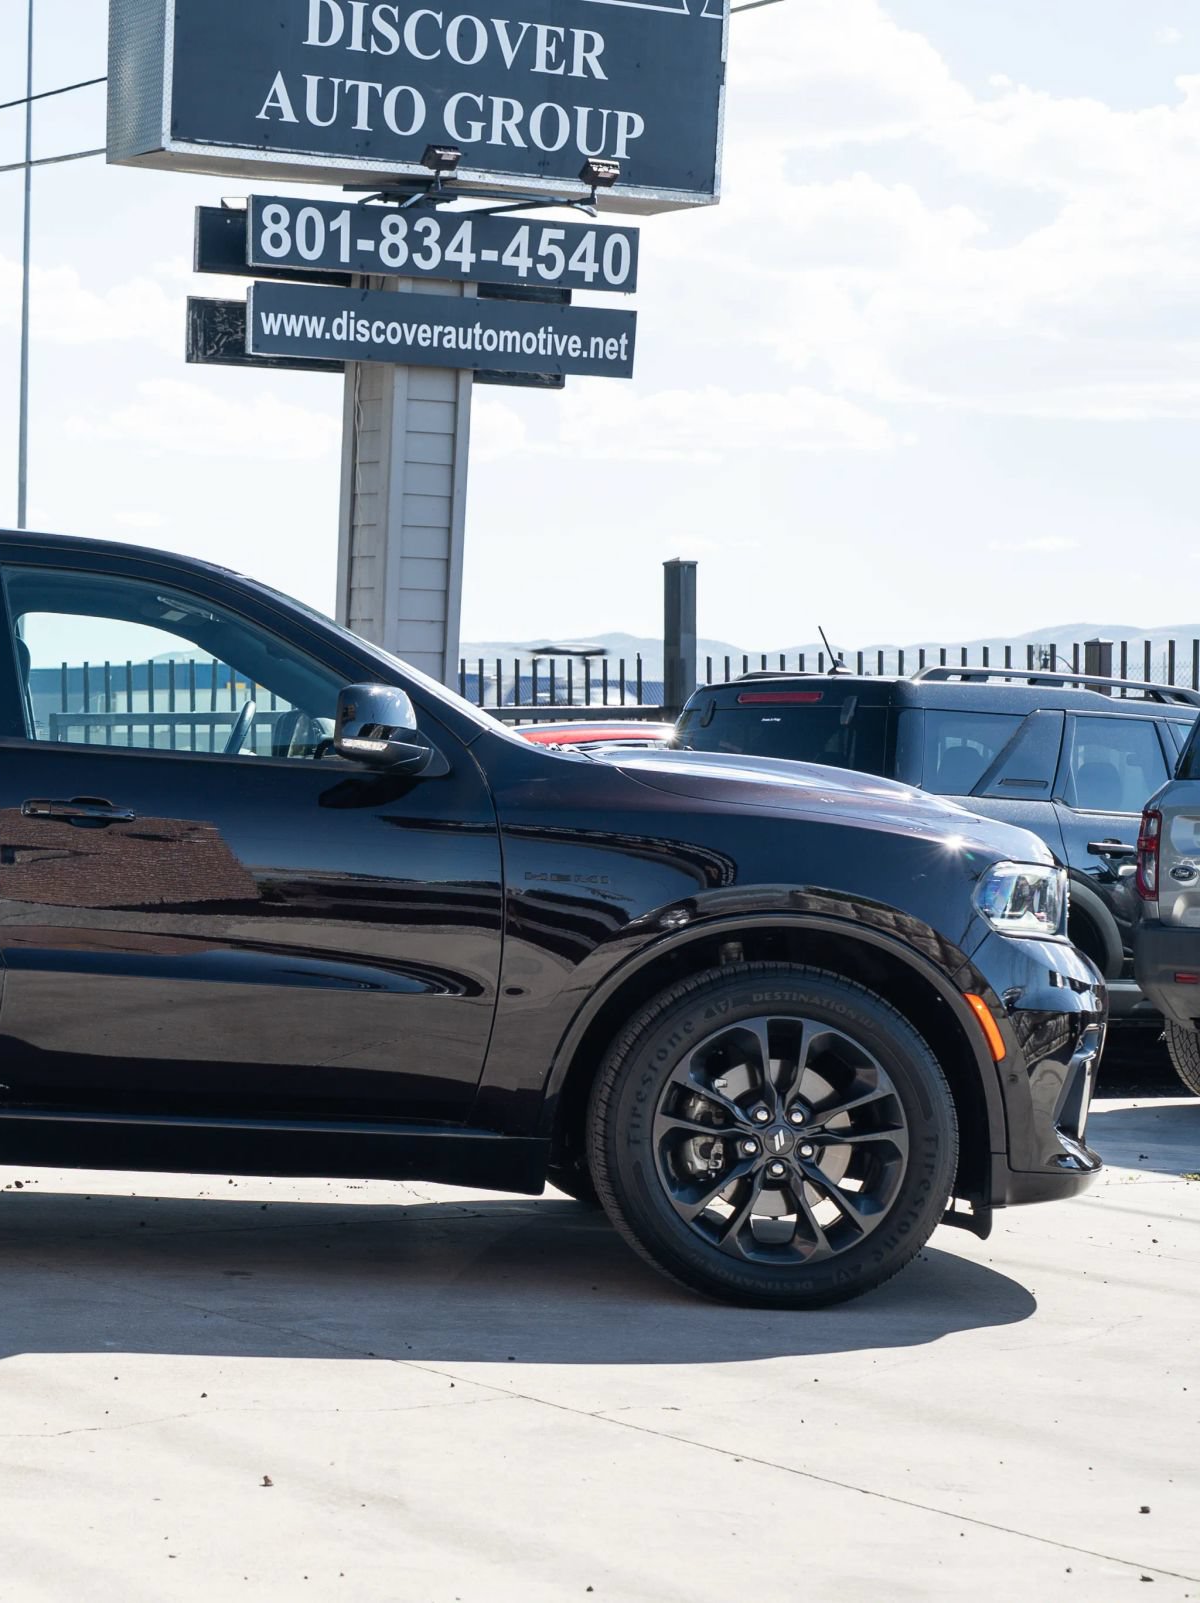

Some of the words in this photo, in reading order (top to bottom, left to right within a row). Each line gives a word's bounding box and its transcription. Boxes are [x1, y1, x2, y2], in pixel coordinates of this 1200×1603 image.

[303, 0, 608, 80] DISCOVER
[256, 70, 426, 136] AUTO
[443, 91, 645, 160] GROUP
[260, 203, 632, 285] 801-834-4540
[259, 311, 629, 362] www.discoverautomotive.net
[752, 990, 859, 1020] DESTINATION
[626, 1020, 696, 1149] Firestone
